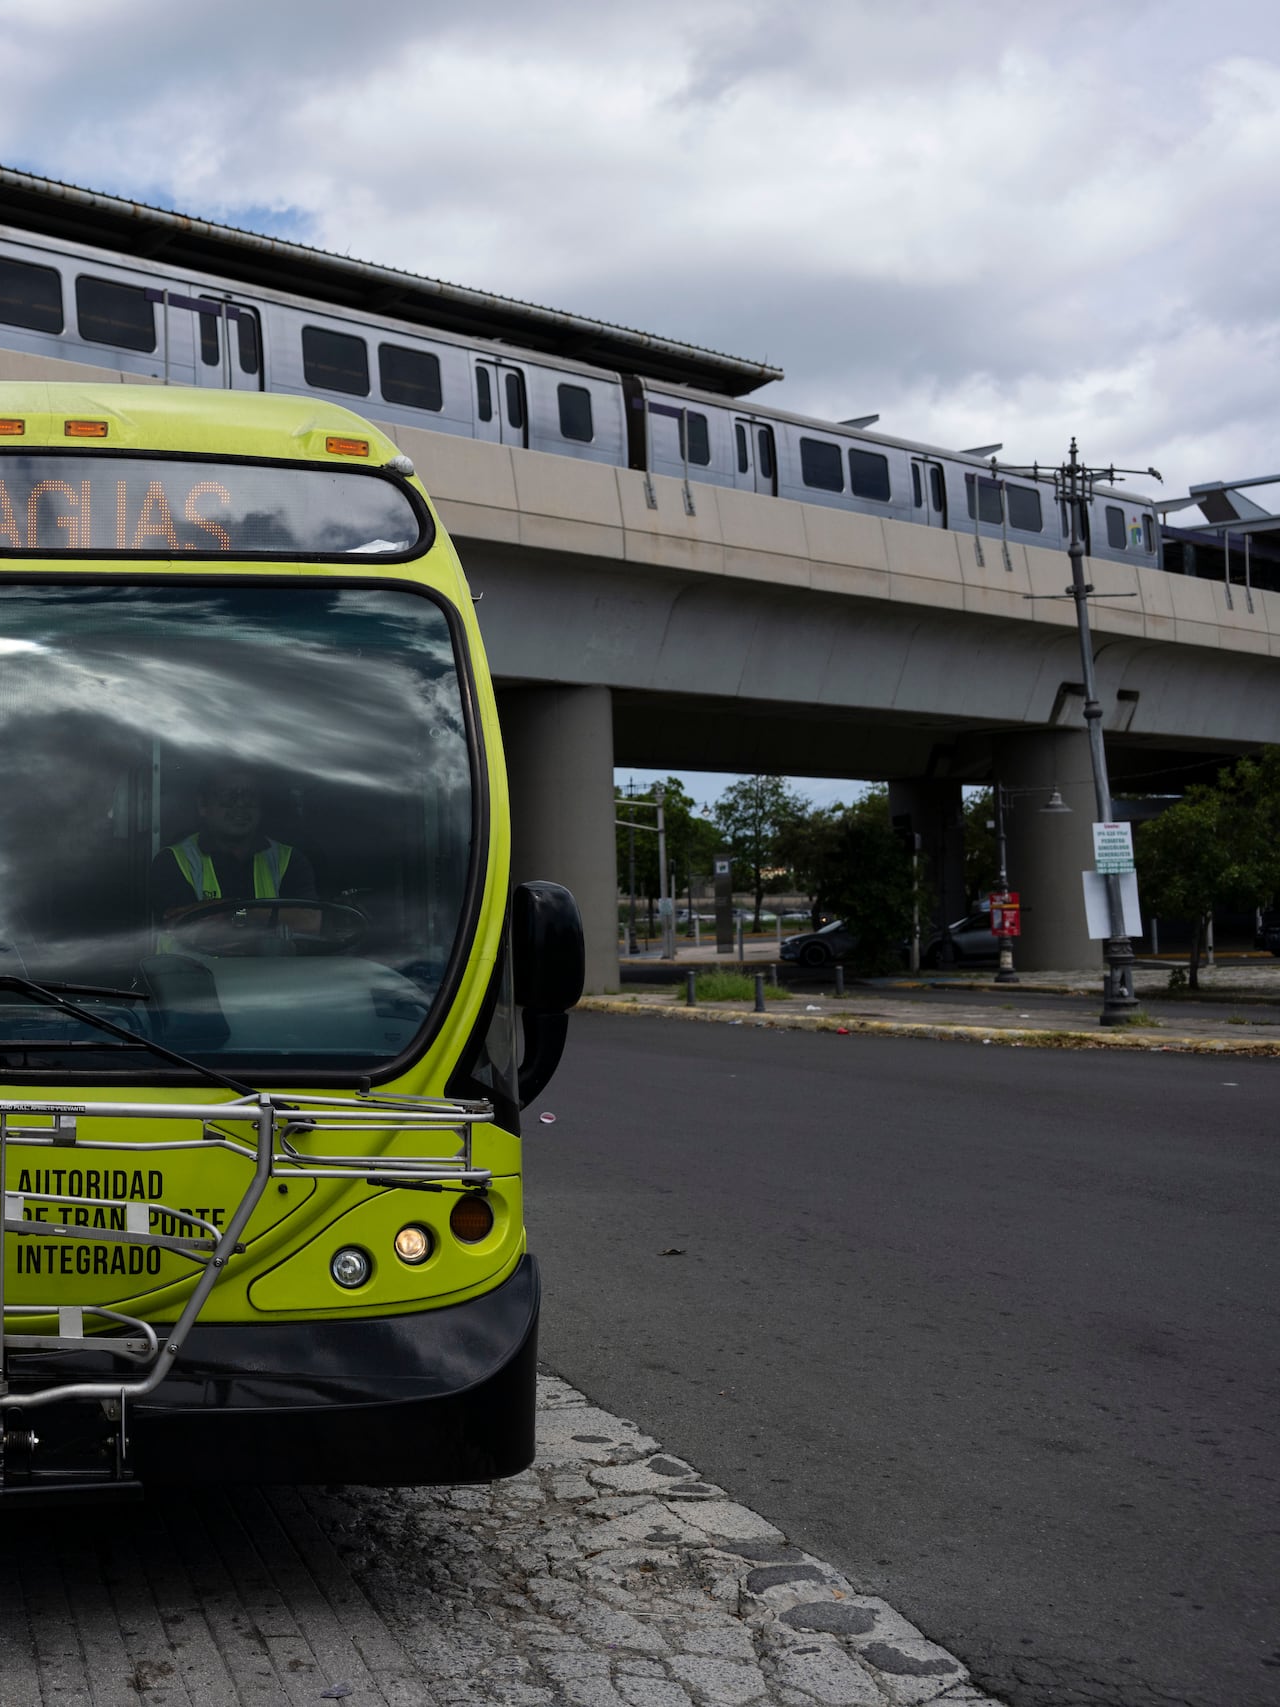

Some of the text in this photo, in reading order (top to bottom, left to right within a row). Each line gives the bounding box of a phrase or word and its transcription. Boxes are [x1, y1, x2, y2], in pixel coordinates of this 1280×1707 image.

[17, 1169, 163, 1200] AUTORIDAD
[58, 1207, 226, 1237] TRANPORTE
[17, 1244, 162, 1275] INTEGRADO
